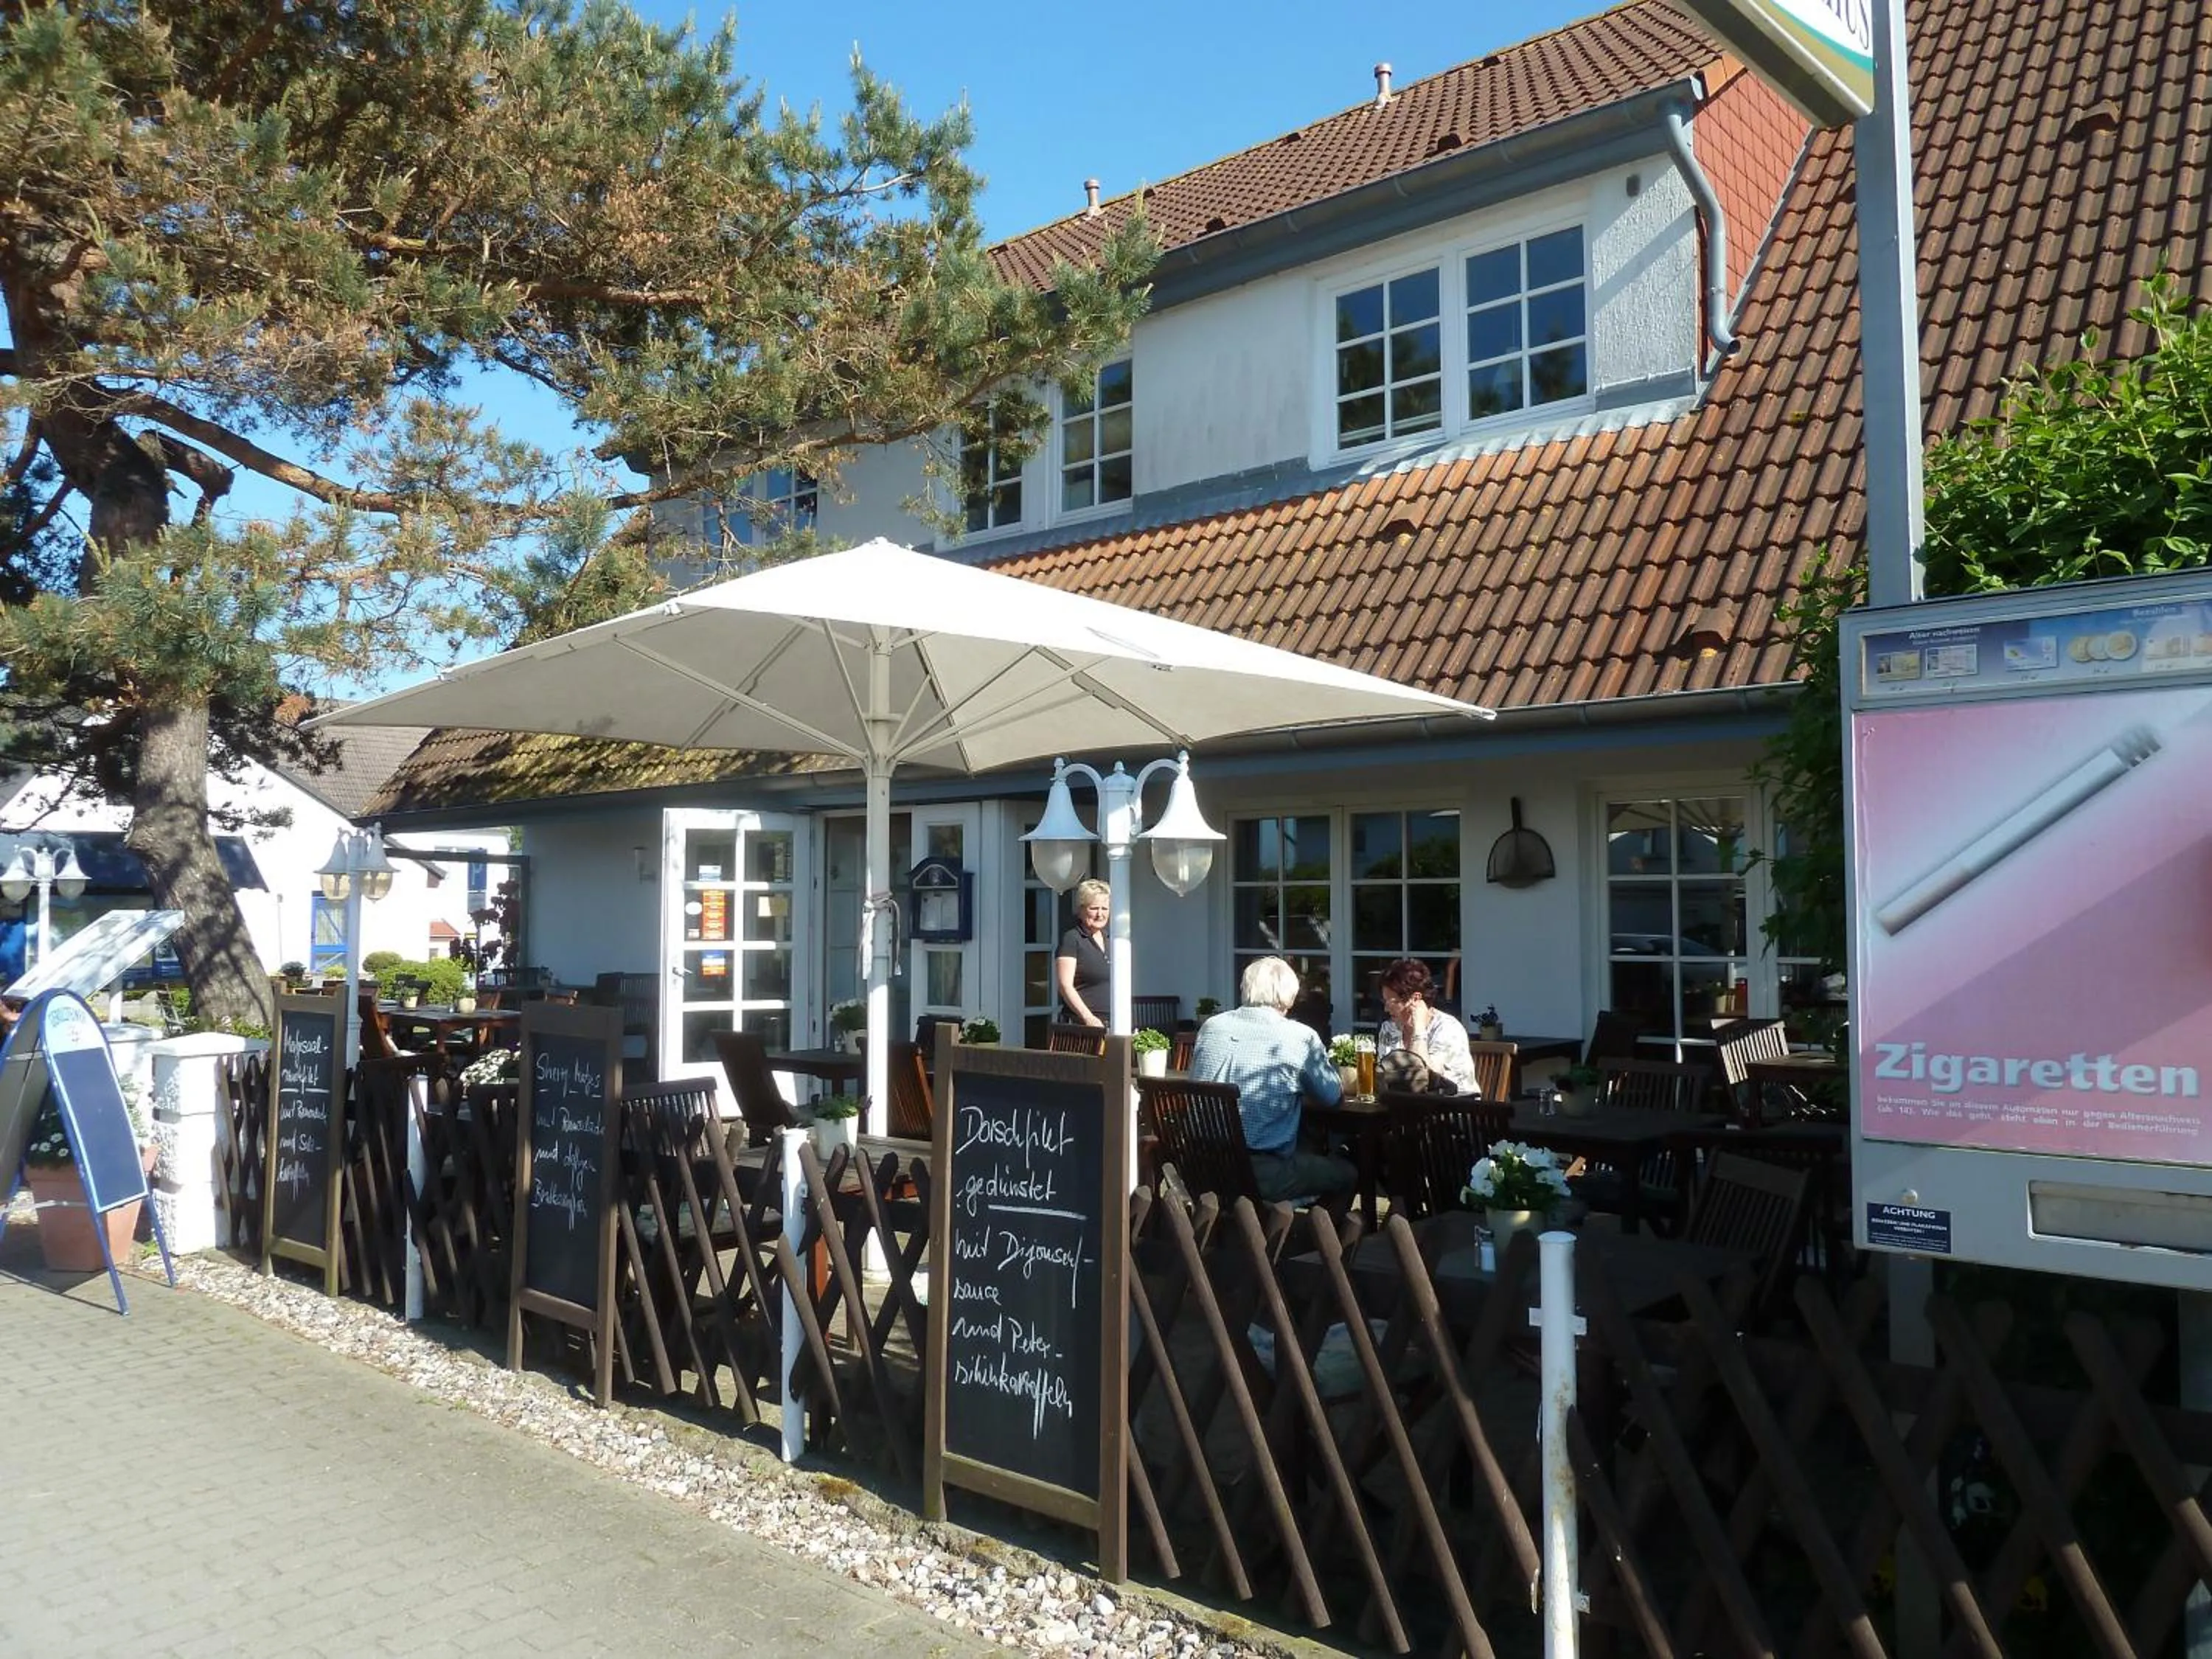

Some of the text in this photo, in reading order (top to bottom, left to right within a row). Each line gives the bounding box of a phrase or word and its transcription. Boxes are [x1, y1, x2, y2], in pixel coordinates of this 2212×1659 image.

[1875, 1042, 2199, 1097] Zigaretten
[1882, 1206, 1935, 1219] ACHTUNG
[956, 1225, 990, 1259] mit
